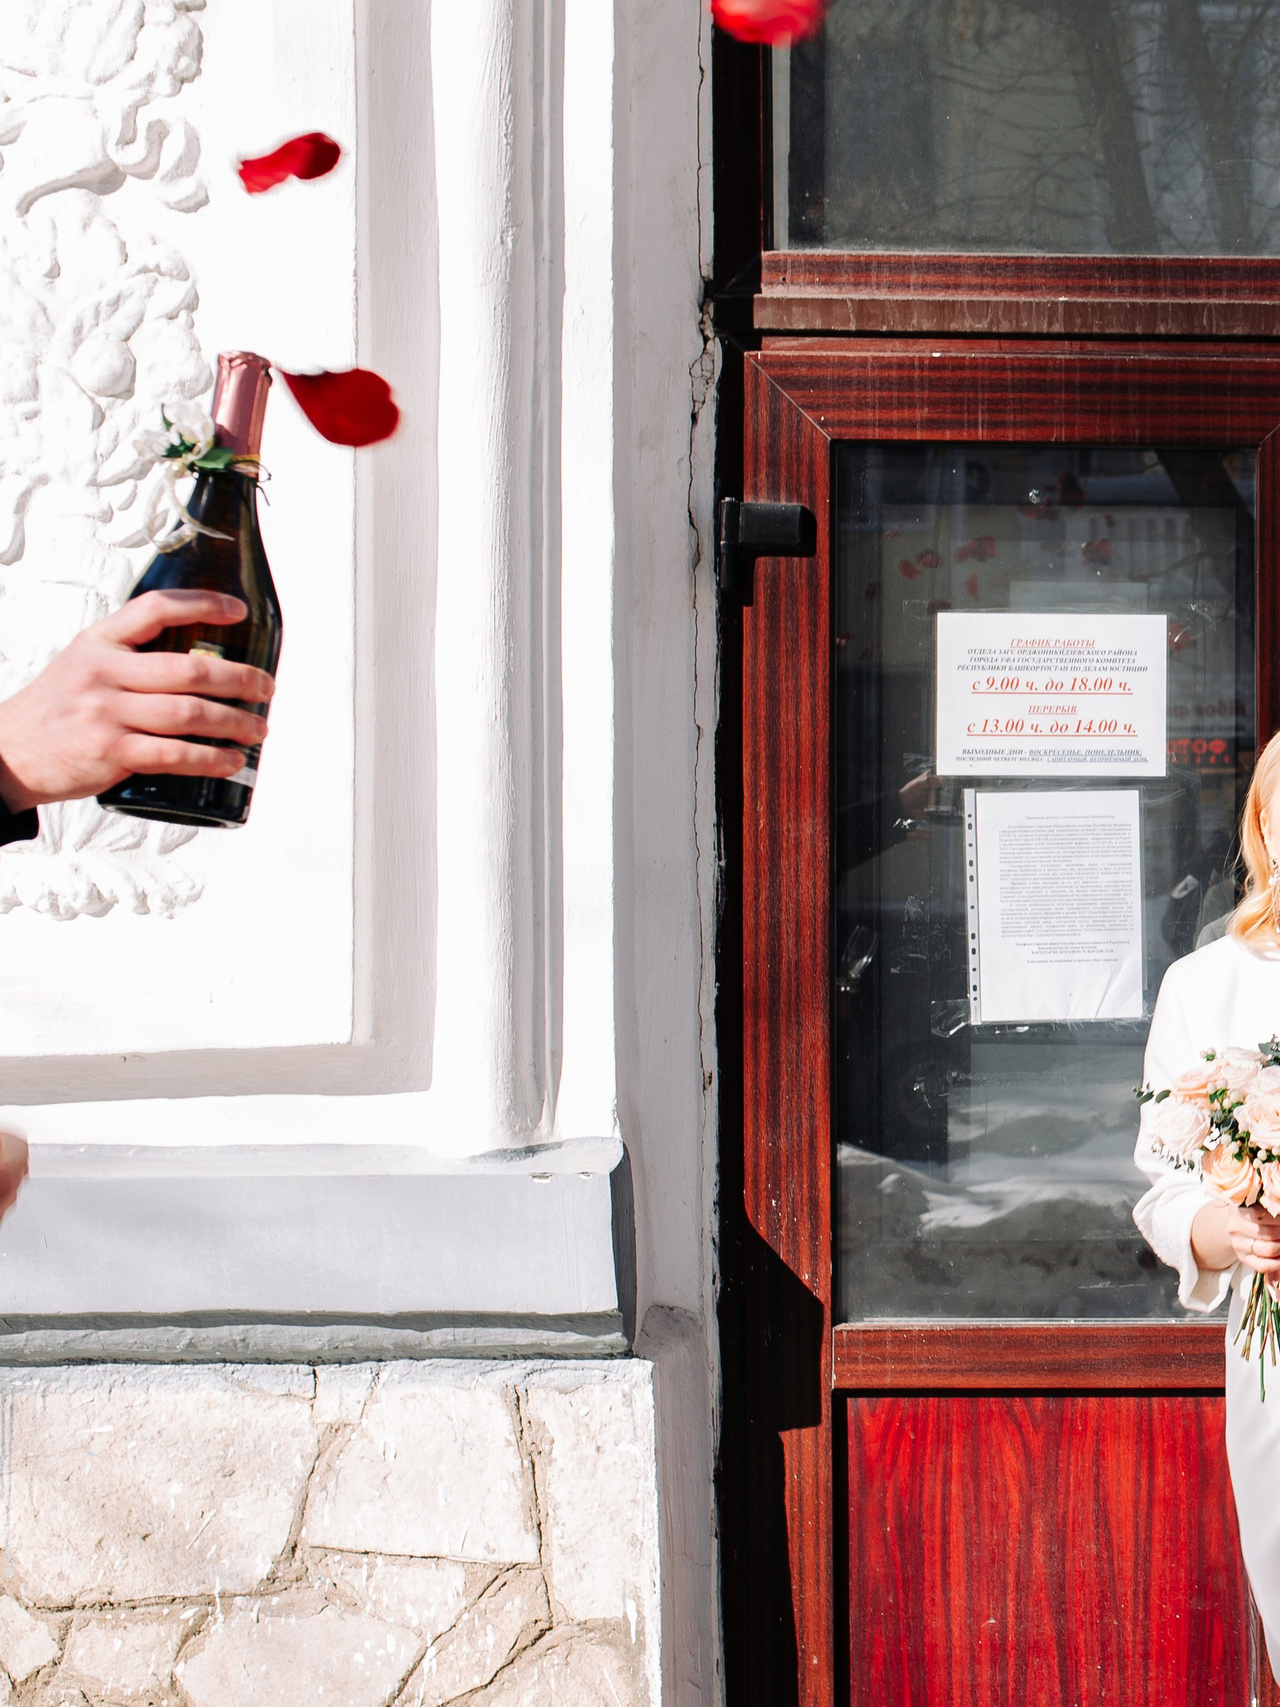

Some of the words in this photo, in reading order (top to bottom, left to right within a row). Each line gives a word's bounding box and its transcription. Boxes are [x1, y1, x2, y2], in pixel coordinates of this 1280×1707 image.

[1010, 638, 1052, 648] ГРАФИК
[1054, 639, 1096, 648] РАБОТЫ
[1017, 648, 1107, 656] ОРДЖОНИКИДЗЕВСКОГО
[1107, 648, 1138, 656] РАЙОНА
[1081, 665, 1108, 673] ДЕЛАМ
[1109, 665, 1149, 673] ЮСТИЦИИ
[985, 676, 1020, 691] 9.00
[1025, 679, 1039, 691] ч.
[1044, 676, 1064, 691] до
[1070, 676, 1113, 692] 18.00
[1118, 680, 1132, 692] ч.
[1028, 705, 1077, 714] ПЕРЕРЫВ
[981, 718, 1025, 733] 13.00
[1030, 723, 1043, 733] ч.
[1049, 718, 1069, 733] до
[1075, 719, 1118, 734] 14.00
[1123, 723, 1137, 734] ч.
[961, 748, 1006, 756] ВЫХОДНЫЕ
